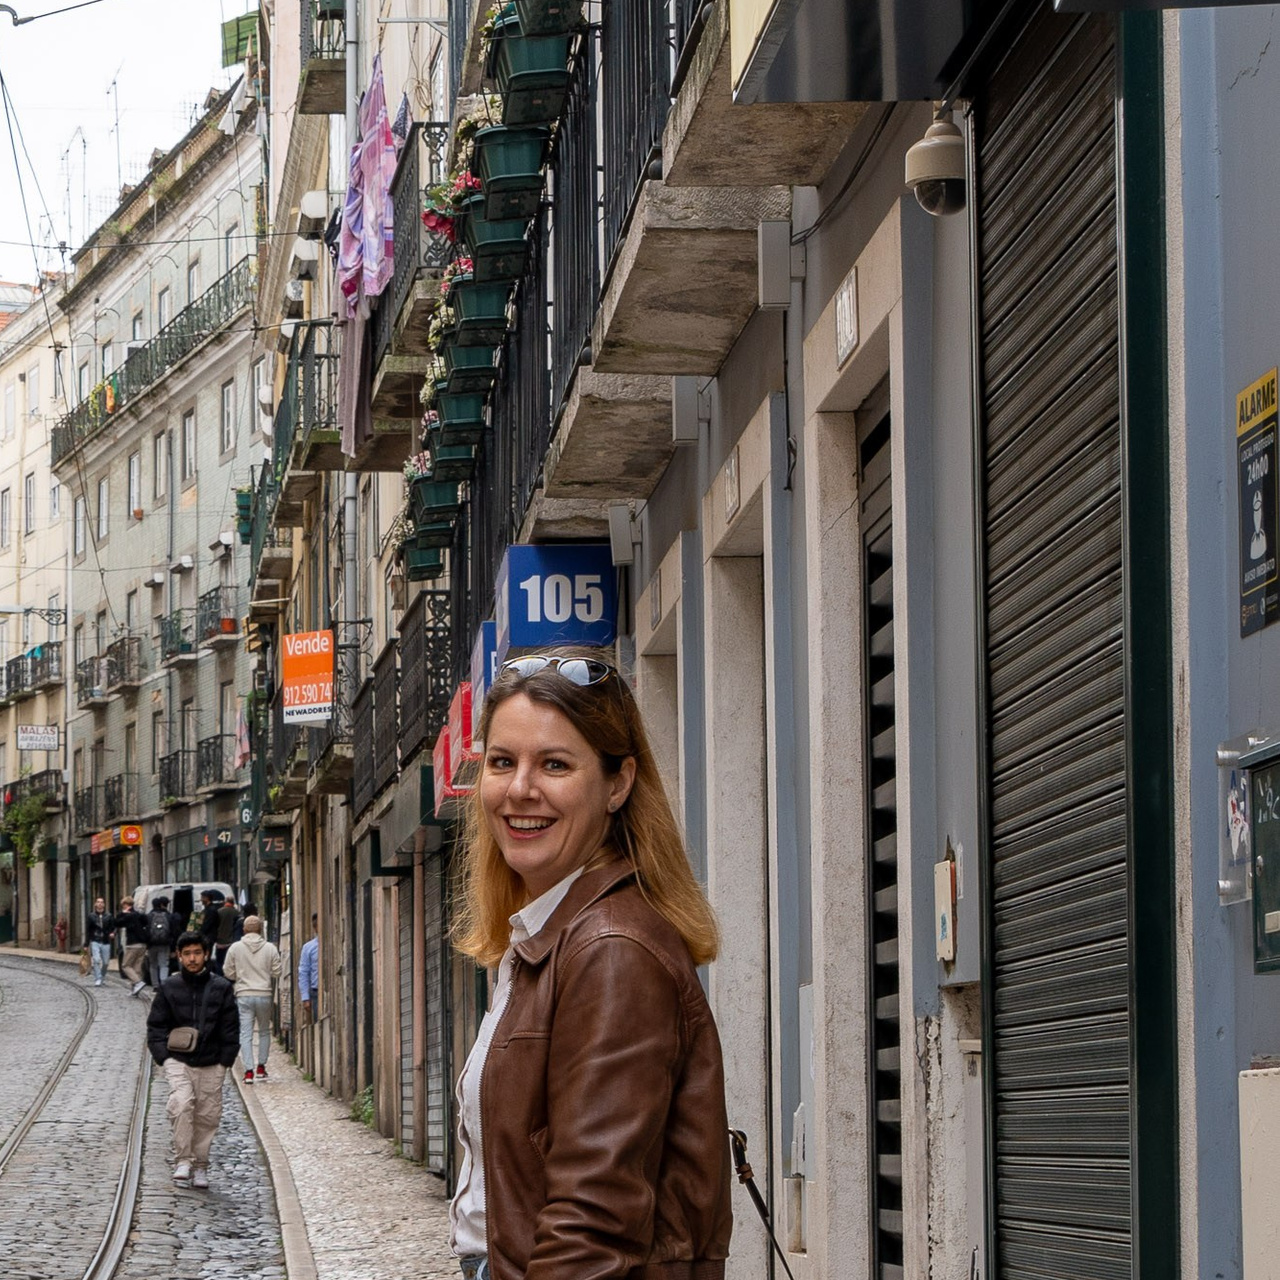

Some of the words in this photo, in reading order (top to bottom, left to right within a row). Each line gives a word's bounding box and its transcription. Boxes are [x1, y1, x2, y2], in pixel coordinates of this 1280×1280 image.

[1239, 378, 1276, 428] ALARME
[519, 574, 604, 623] 105
[285, 632, 329, 656] Vende
[283, 685, 300, 706] 912
[301, 682, 318, 704] 590
[319, 681, 333, 701] 74
[20, 726, 56, 735] MALAS
[217, 831, 231, 843] 47
[262, 837, 285, 852] 75
